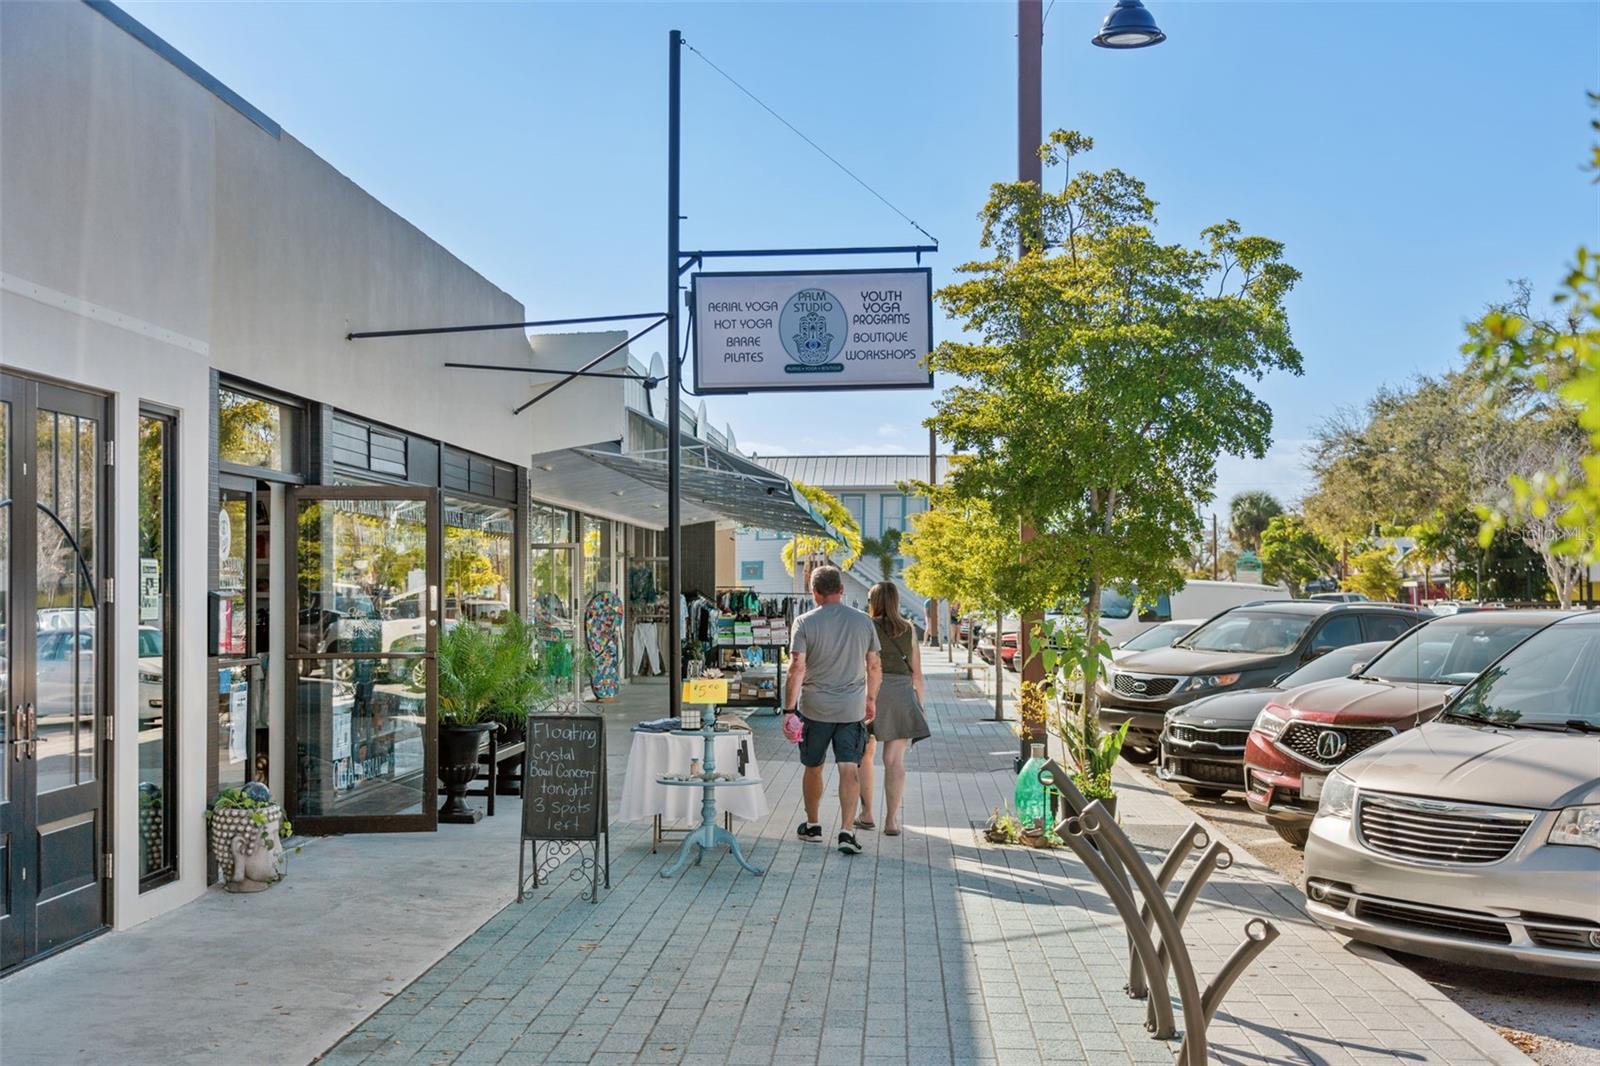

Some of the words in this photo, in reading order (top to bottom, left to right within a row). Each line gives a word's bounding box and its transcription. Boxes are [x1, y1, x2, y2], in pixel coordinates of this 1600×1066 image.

[798, 291, 827, 302] PALM
[861, 290, 902, 302] YOUTH
[708, 302, 743, 312] AERIAL
[745, 301, 779, 312] YOGA
[793, 302, 833, 313] STUDIO
[863, 302, 900, 313] YOGA
[714, 319, 737, 330] HOT
[739, 318, 773, 329] YOGA
[853, 313, 910, 325] PROGRAMS
[726, 336, 761, 348] BARRE
[853, 331, 908, 343] BOUTIQUE
[724, 352, 764, 363] PILATES
[845, 349, 916, 361] WORKSHOPS
[533, 722, 597, 748] Floating
[532, 743, 575, 764] Crystal
[529, 759, 553, 777] Bowl
[555, 762, 597, 780] Concert
[534, 796, 545, 813] 3
[547, 815, 580, 831] left
